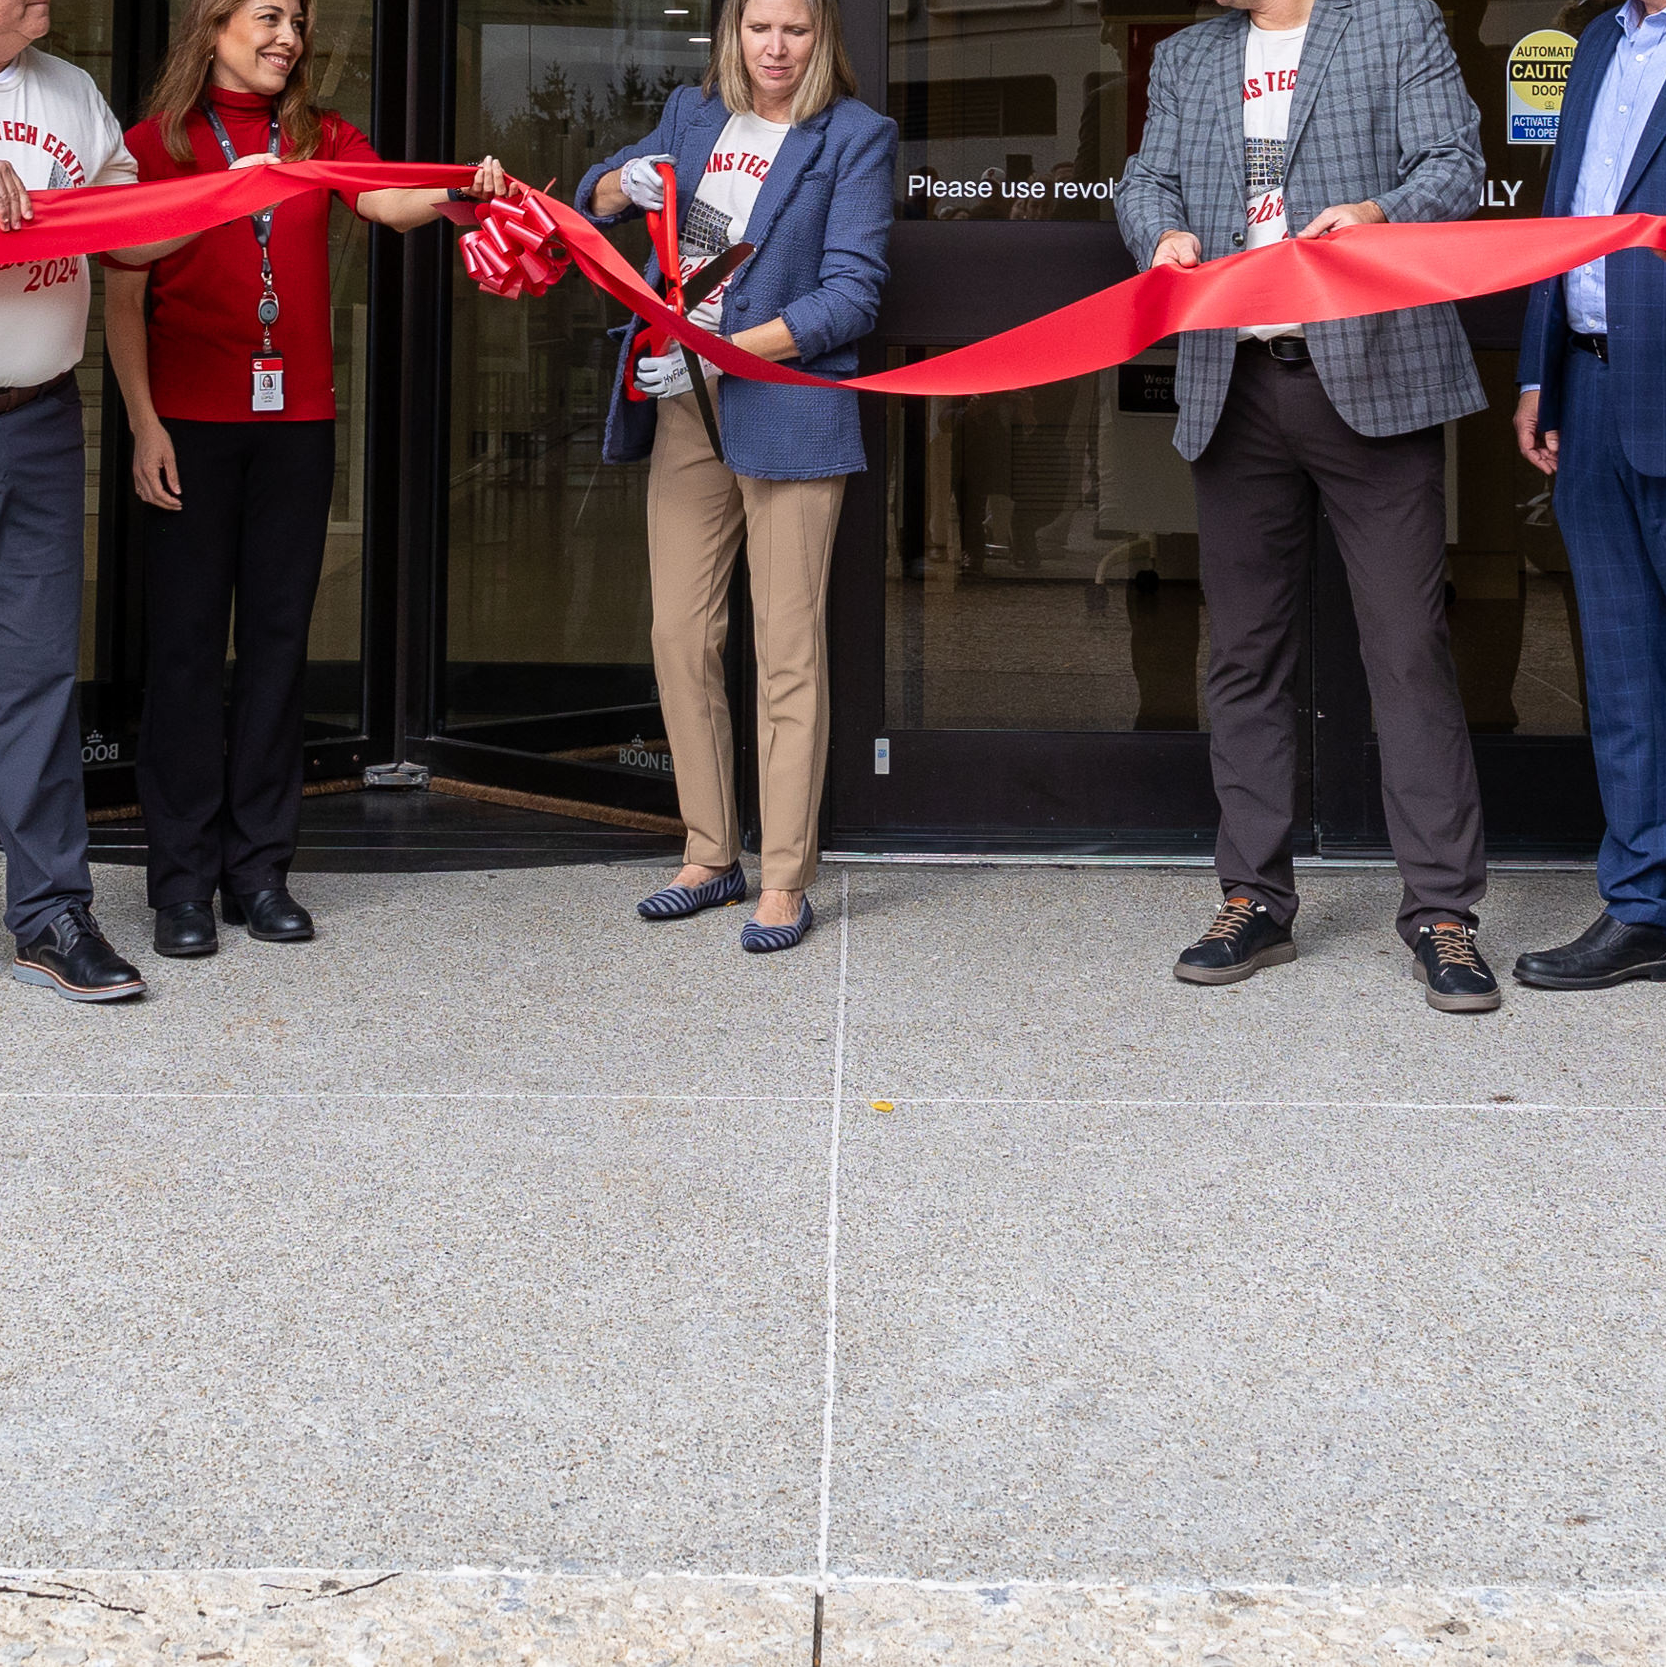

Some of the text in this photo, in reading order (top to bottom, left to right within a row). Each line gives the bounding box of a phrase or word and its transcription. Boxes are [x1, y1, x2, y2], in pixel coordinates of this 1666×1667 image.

[1516, 46, 1574, 58] AUTOMATI
[1514, 116, 1553, 127] ACTIVATE
[1524, 128, 1536, 138] TO
[737, 152, 770, 183] TEC
[908, 175, 1118, 199] Please use revol
[1479, 180, 1523, 207] LY
[23, 255, 79, 293] 2024
[619, 748, 660, 770] BOON
